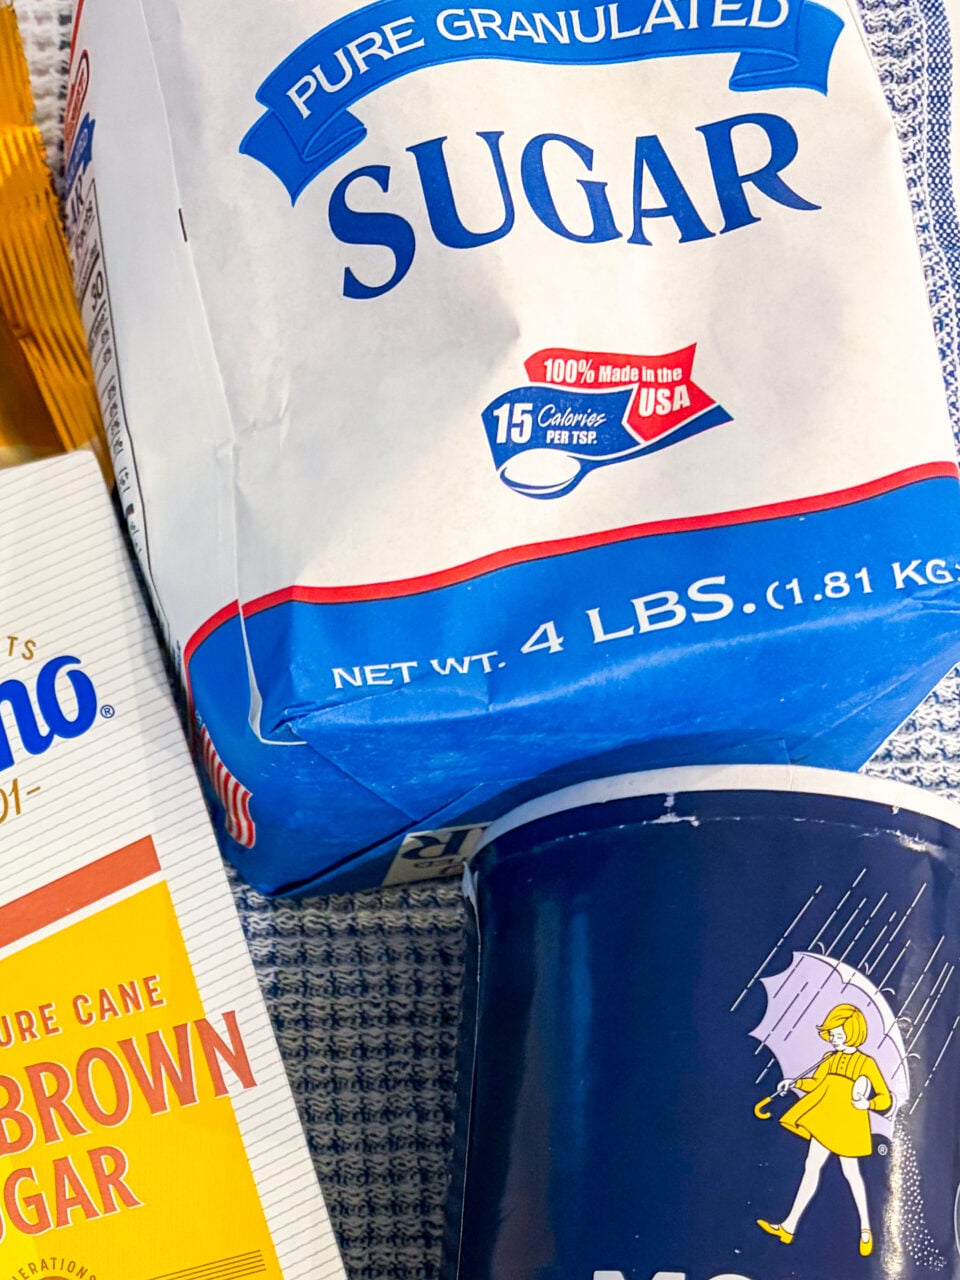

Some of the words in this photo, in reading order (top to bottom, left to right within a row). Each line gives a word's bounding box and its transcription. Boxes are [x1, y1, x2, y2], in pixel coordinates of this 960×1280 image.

[286, 15, 425, 119] PURE
[436, 0, 790, 45] GRANULATED
[328, 112, 823, 299] SUGAR
[544, 358, 594, 384] 100%
[599, 365, 639, 383] Made
[642, 366, 655, 382] in
[657, 367, 682, 384] the
[493, 403, 533, 444] 15
[538, 404, 607, 428] Calories
[638, 384, 691, 417] USA
[546, 430, 571, 444] PER
[572, 430, 597, 444] TSP.
[332, 661, 418, 690] NET
[431, 650, 506, 676] WT.
[520, 621, 564, 656] 4
[586, 575, 756, 644] LBS.
[766, 567, 875, 611] (1.81
[891, 558, 960, 589] KG
[72, 975, 165, 1027] CANE
